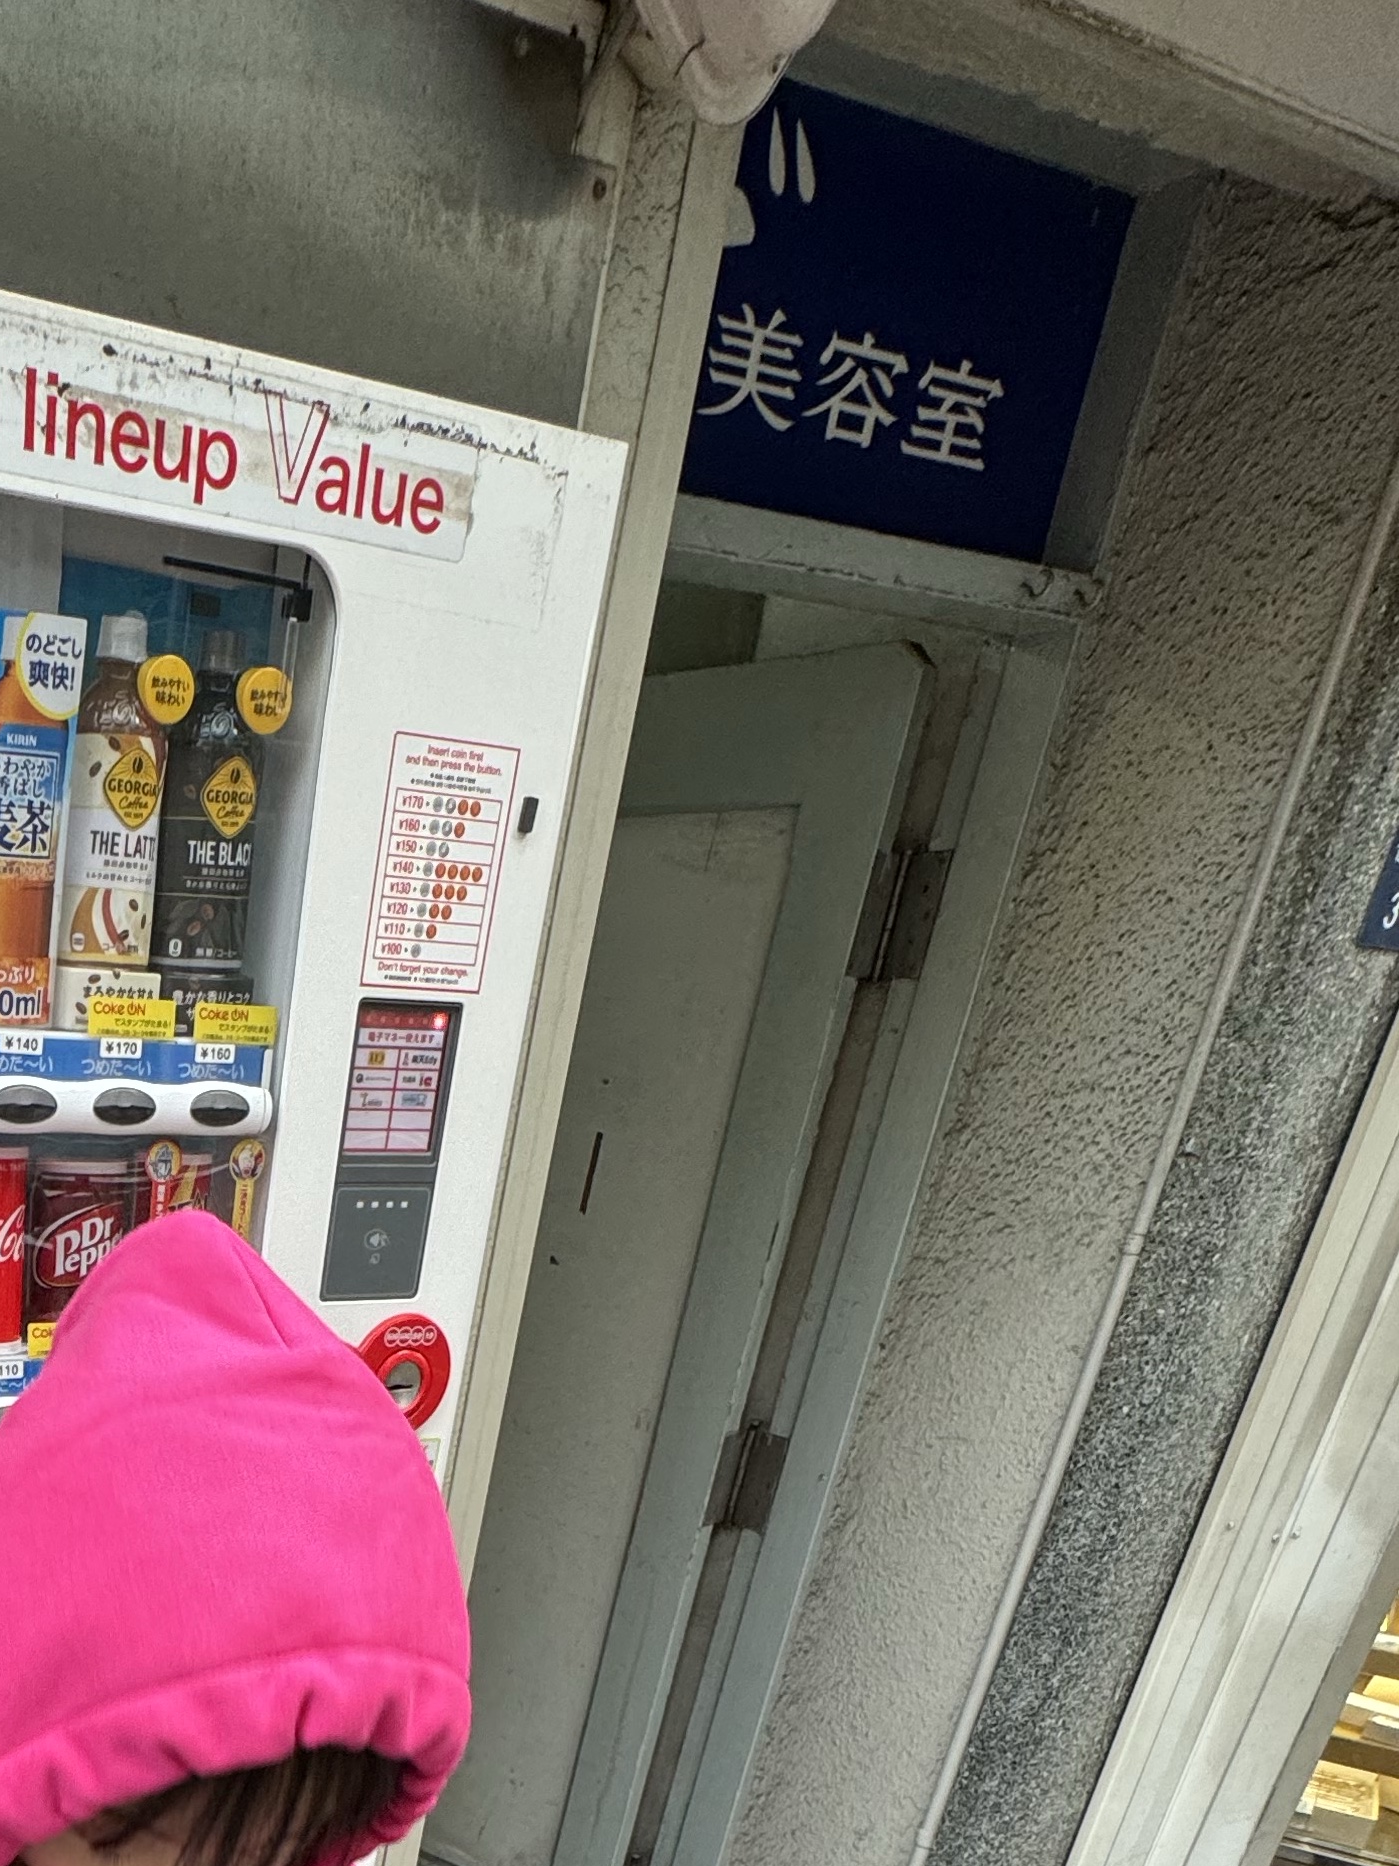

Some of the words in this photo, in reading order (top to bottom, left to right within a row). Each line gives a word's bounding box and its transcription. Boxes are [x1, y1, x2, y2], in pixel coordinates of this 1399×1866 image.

[696, 303, 1005, 471] 美容室
[24, 365, 237, 505] lineup
[265, 391, 445, 535] Value
[25, 633, 83, 657] のどごし
[6, 733, 37, 747] KIRIN
[427, 744, 450, 757] Insert
[451, 748, 468, 759] coin
[469, 751, 484, 762] first
[405, 755, 420, 765] and
[422, 756, 439, 767] then
[440, 760, 462, 771] press
[463, 762, 475, 772] the
[402, 796, 424, 809] ¥170
[399, 819, 421, 832] ¥160
[90, 830, 122, 857] THE
[396, 840, 417, 853] ¥150
[187, 840, 217, 865] THE
[393, 861, 414, 873] ¥140
[390, 881, 411, 895] ¥130
[387, 901, 407, 915] ¥120
[384, 922, 405, 935] ¥110
[381, 943, 402, 956] ¥100
[399, 963, 420, 975] forget
[422, 967, 439, 976] your
[93, 1001, 124, 1016] Coke
[199, 1007, 229, 1021] Coke
[4, 1036, 39, 1052] ¥140
[105, 1042, 138, 1056] ¥170
[200, 1047, 231, 1061] ¥160
[81, 1216, 115, 1249] Dr
